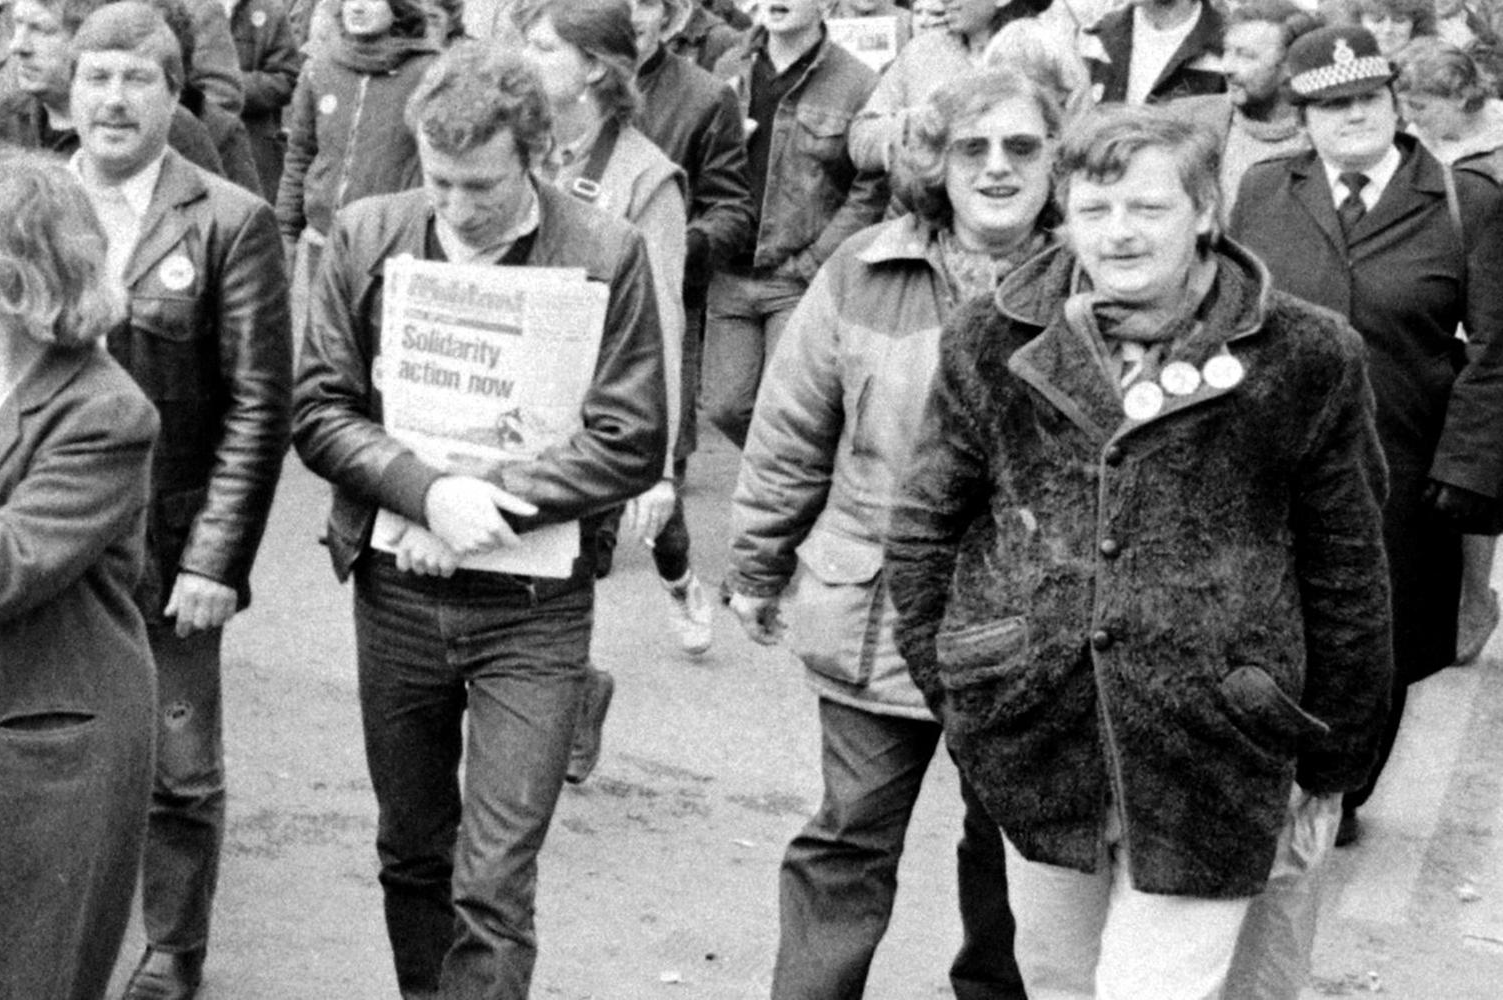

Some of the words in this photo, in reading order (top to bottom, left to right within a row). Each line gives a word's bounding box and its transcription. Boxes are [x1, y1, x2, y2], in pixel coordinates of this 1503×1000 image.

[401, 323, 502, 369] Solidarity
[398, 358, 462, 389] action
[467, 374, 515, 399] now
